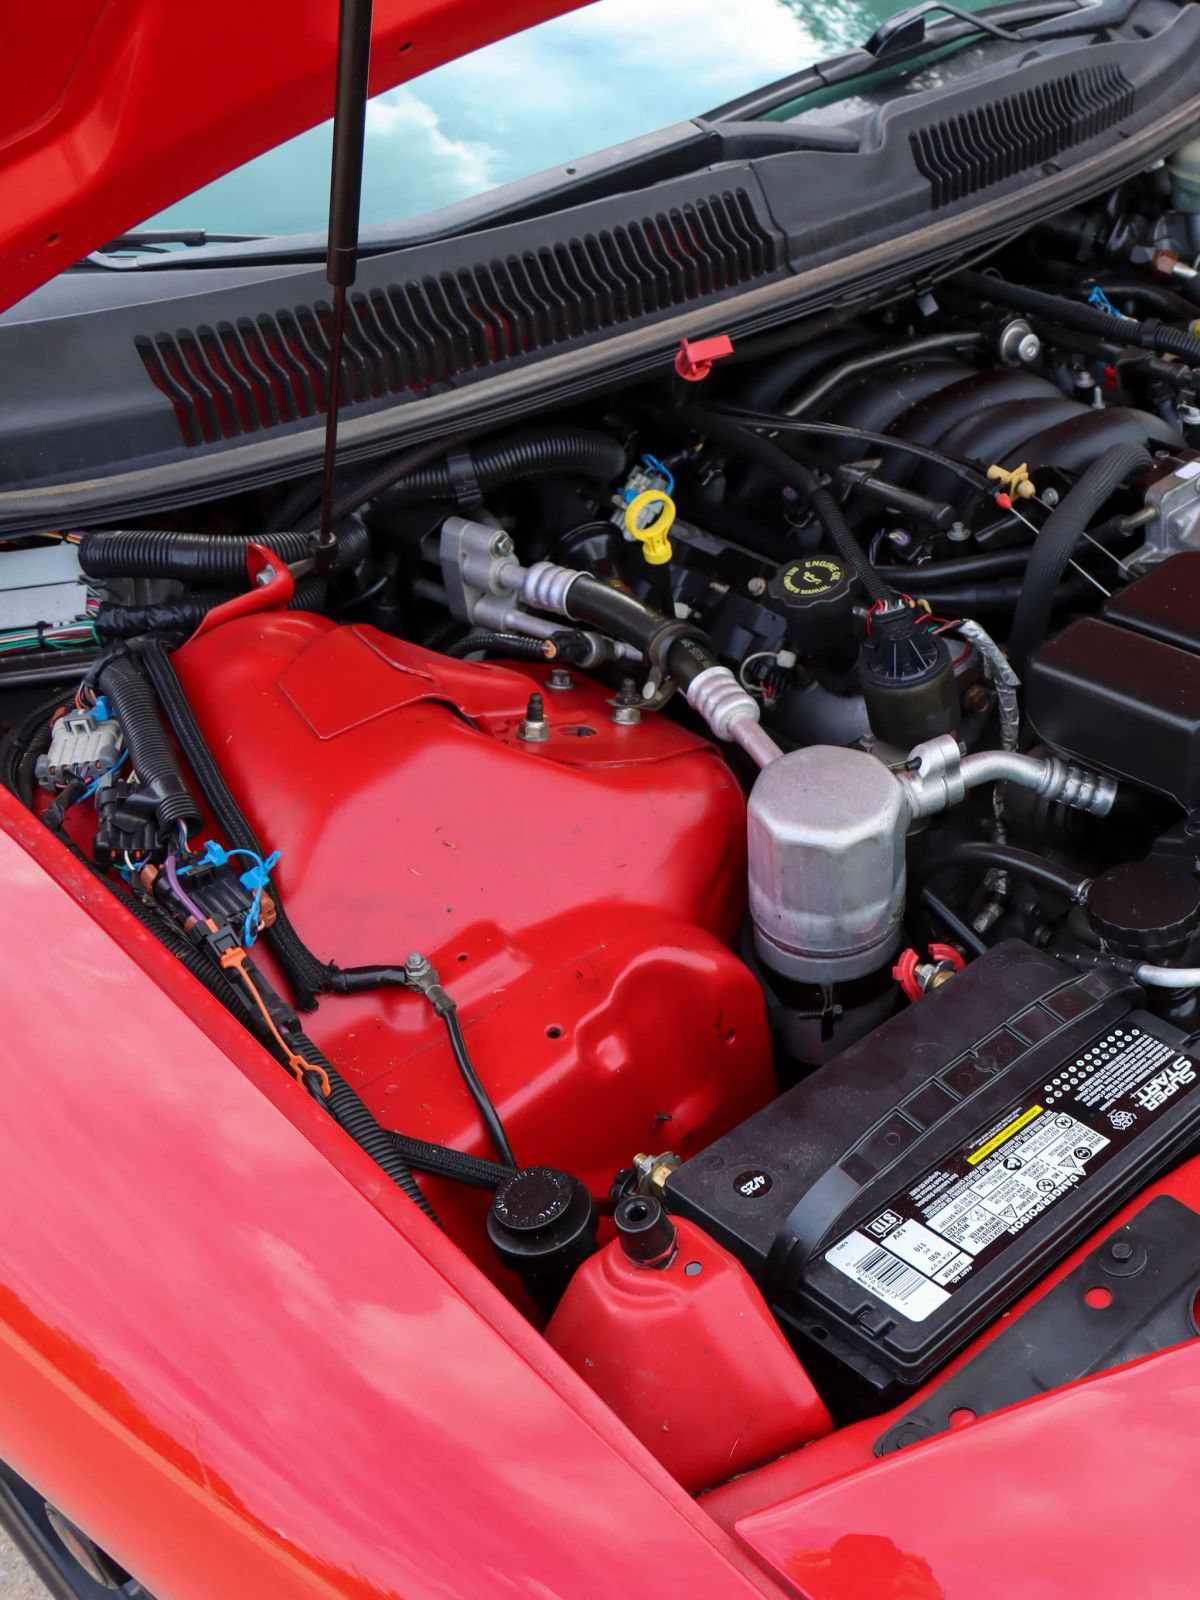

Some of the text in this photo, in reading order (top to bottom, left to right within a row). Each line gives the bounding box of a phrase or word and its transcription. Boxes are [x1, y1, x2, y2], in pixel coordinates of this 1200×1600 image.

[805, 560, 841, 581] ENGINE OIL
[800, 585, 832, 595] MANUAL
[1129, 1054, 1196, 1108] START
[1141, 1067, 1198, 1113] SUPER
[1006, 1173, 1080, 1235] DANGER/POISON
[1018, 1189, 1031, 1199] ACID
[868, 1211, 898, 1234] STD
[948, 1222, 970, 1240] MEDICAL
[972, 1219, 1002, 1244] IMMEDIATELY
[890, 1227, 907, 1240] 12V
[981, 1223, 1008, 1245] FLUSH EYES
[940, 1258, 965, 1279] 78PRM
[950, 1264, 973, 1284] PART NO.
